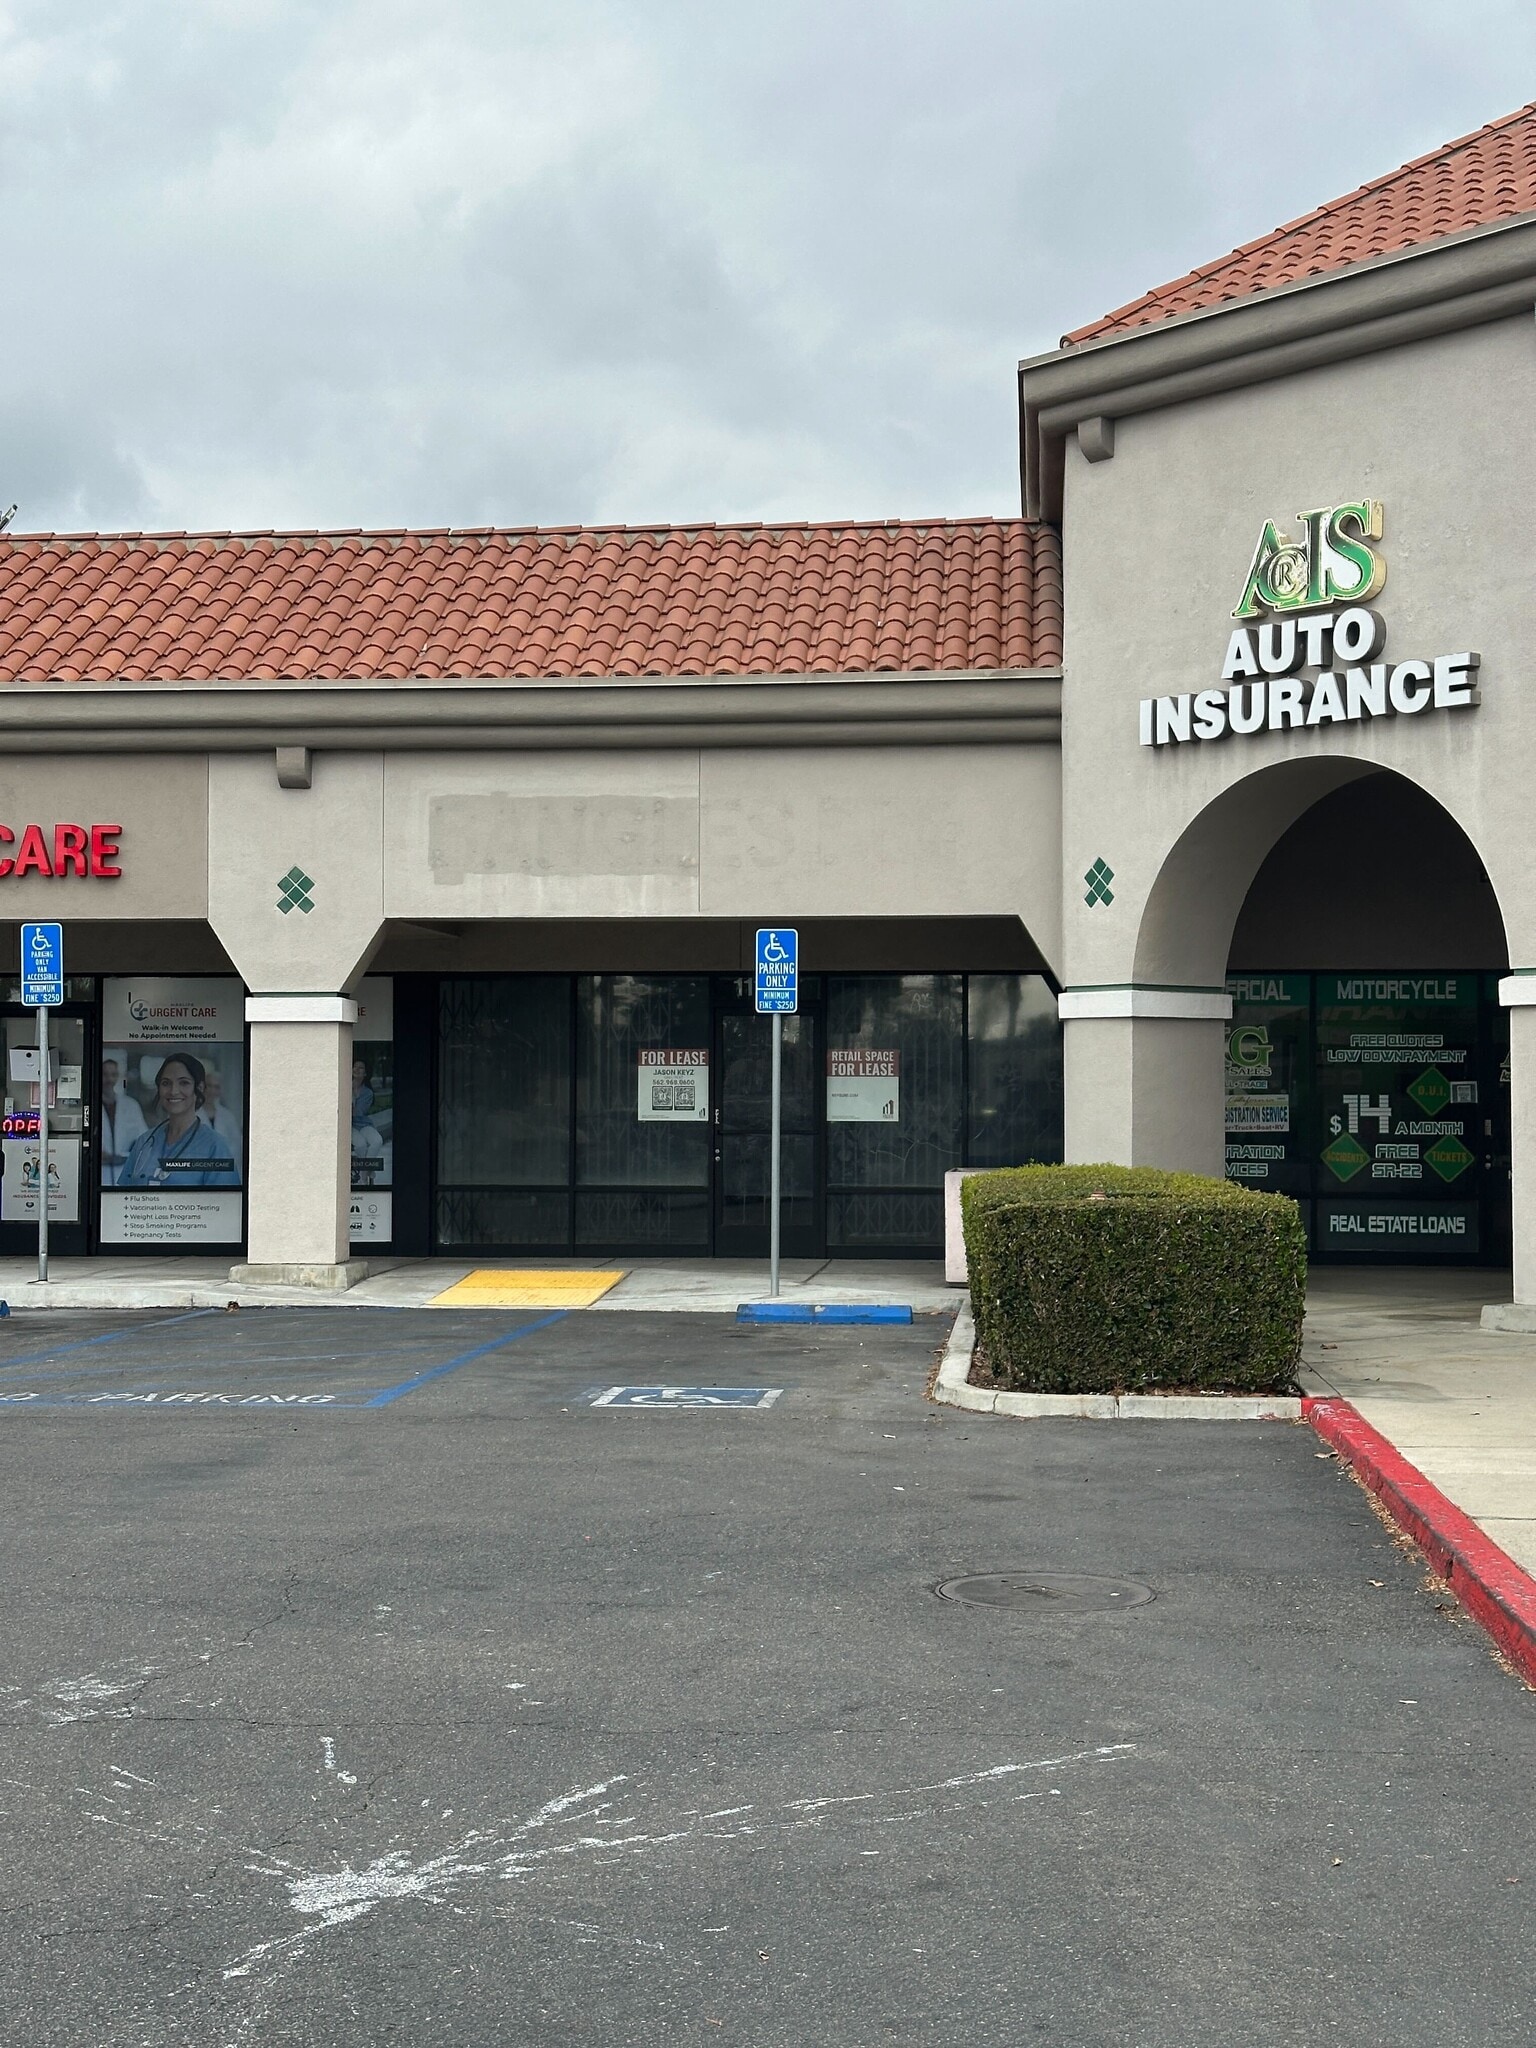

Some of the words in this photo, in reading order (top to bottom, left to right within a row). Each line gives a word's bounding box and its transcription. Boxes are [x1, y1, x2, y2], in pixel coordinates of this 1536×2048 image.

[1221, 608, 1386, 681] AUTO
[1139, 652, 1481, 747] INSURANCE
[31, 951, 54, 959] PARKING
[759, 962, 795, 975] PARKING
[27, 973, 58, 981] ACCESSIBLE
[765, 975, 788, 988] ONLY
[29, 984, 56, 993] MINIMUM
[1225, 979, 1291, 1001] ERCIAL
[1337, 980, 1457, 1000] MOTORCYCLE
[25, 994, 39, 1003] FINE
[763, 991, 790, 1000] MINIMUM
[759, 1001, 773, 1010] FINE
[149, 1007, 189, 1018] URGENT
[191, 1007, 217, 1018] CARE
[140, 1032, 187, 1040] Appointment
[1350, 1034, 1386, 1048] FREE
[1387, 1034, 1444, 1048] QUOTES
[641, 1051, 666, 1066] FOR
[669, 1051, 707, 1066] LEASE
[831, 1051, 863, 1062] RETAIL
[865, 1051, 895, 1062] SPACE
[1327, 1049, 1361, 1063] LOW
[831, 1063, 856, 1076] FOR
[859, 1063, 895, 1076] LEASE
[1225, 1106, 1261, 1123] GISTRATION
[1261, 1106, 1288, 1123] SERVICE
[1394, 1121, 1409, 1135] A
[1409, 1121, 1464, 1135] MONTH
[1225, 1144, 1285, 1159] TRATION
[1375, 1144, 1419, 1159] FREE
[1432, 1150, 1468, 1164] TICKETS
[1225, 1162, 1268, 1177] VICES
[1372, 1163, 1423, 1178] SR-22
[197, 1204, 220, 1212] Testing
[130, 1222, 145, 1230] Stop
[145, 1222, 175, 1230] Smoking
[175, 1222, 207, 1230] Programs
[1330, 1215, 1365, 1232] REAL
[1368, 1215, 1417, 1233] ESTATE
[1419, 1216, 1466, 1234] LOANS
[130, 1231, 164, 1239] Pregnancy
[88, 1392, 336, 1404] PARKING
